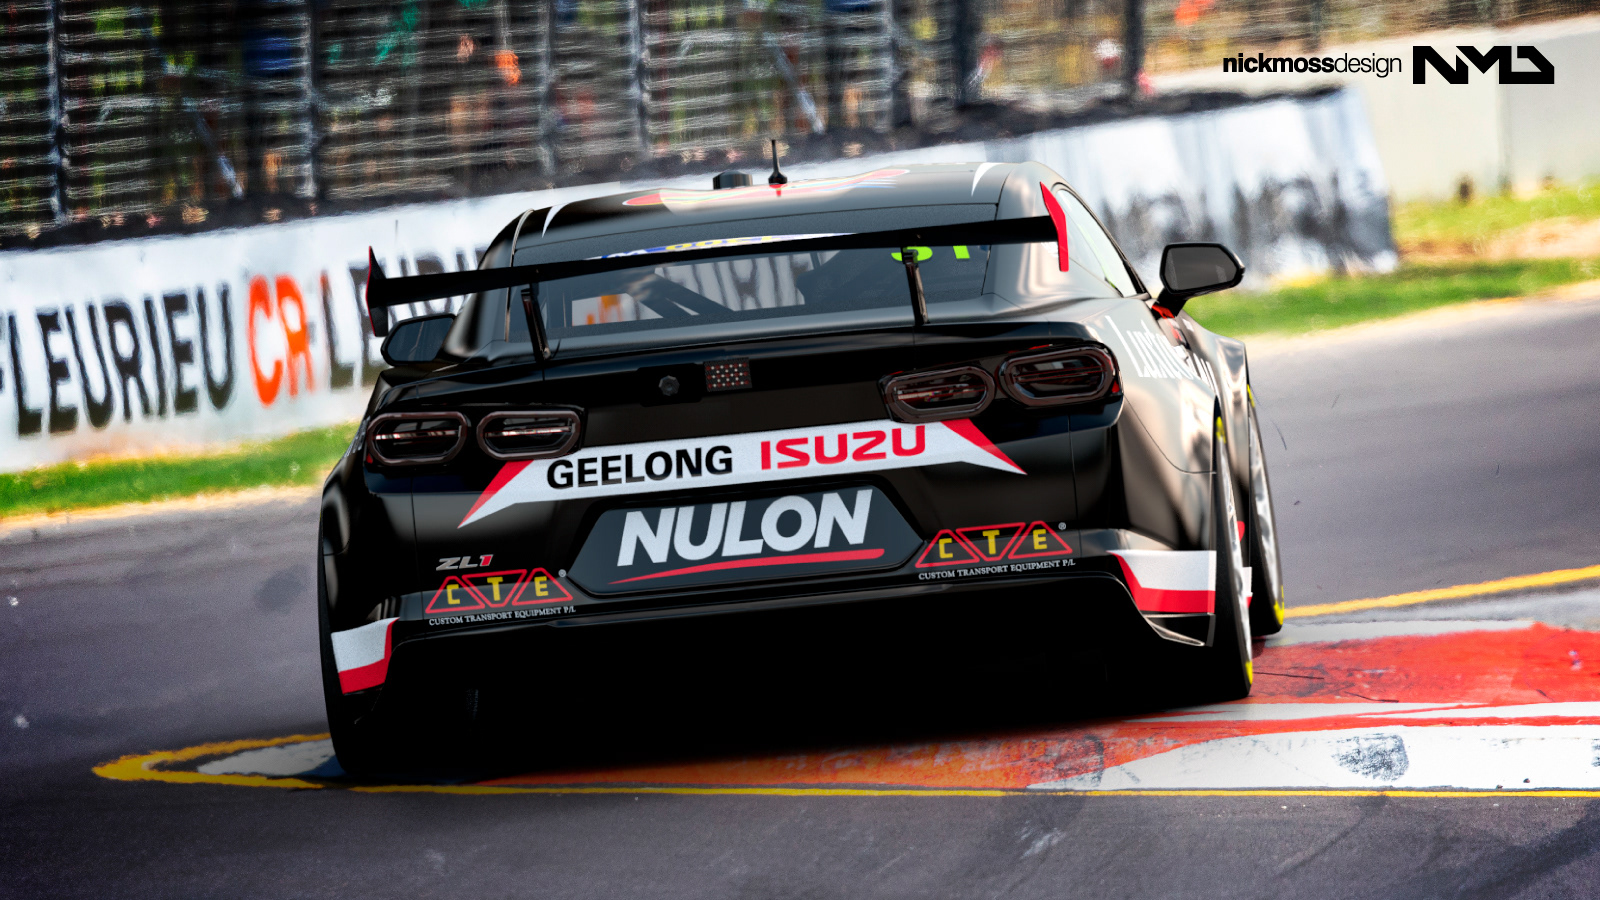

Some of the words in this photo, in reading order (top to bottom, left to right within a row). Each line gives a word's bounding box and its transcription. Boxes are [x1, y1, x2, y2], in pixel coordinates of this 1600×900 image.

[0, 282, 236, 434] LEURIEU
[547, 445, 733, 490] GEELONG
[761, 425, 926, 470] ISUZU
[617, 489, 873, 567] NULON
[436, 554, 494, 571] ZL1
[918, 571, 956, 580] CUSTOM
[957, 565, 1009, 577] TRANSPORT
[1010, 560, 1061, 572] EQUIPMENT
[1062, 558, 1077, 567] P/L
[428, 617, 464, 626] CUSTOM
[464, 612, 513, 623] TRANSPORT
[514, 606, 562, 618] EQUIPMENT
[563, 605, 577, 613] P/L
